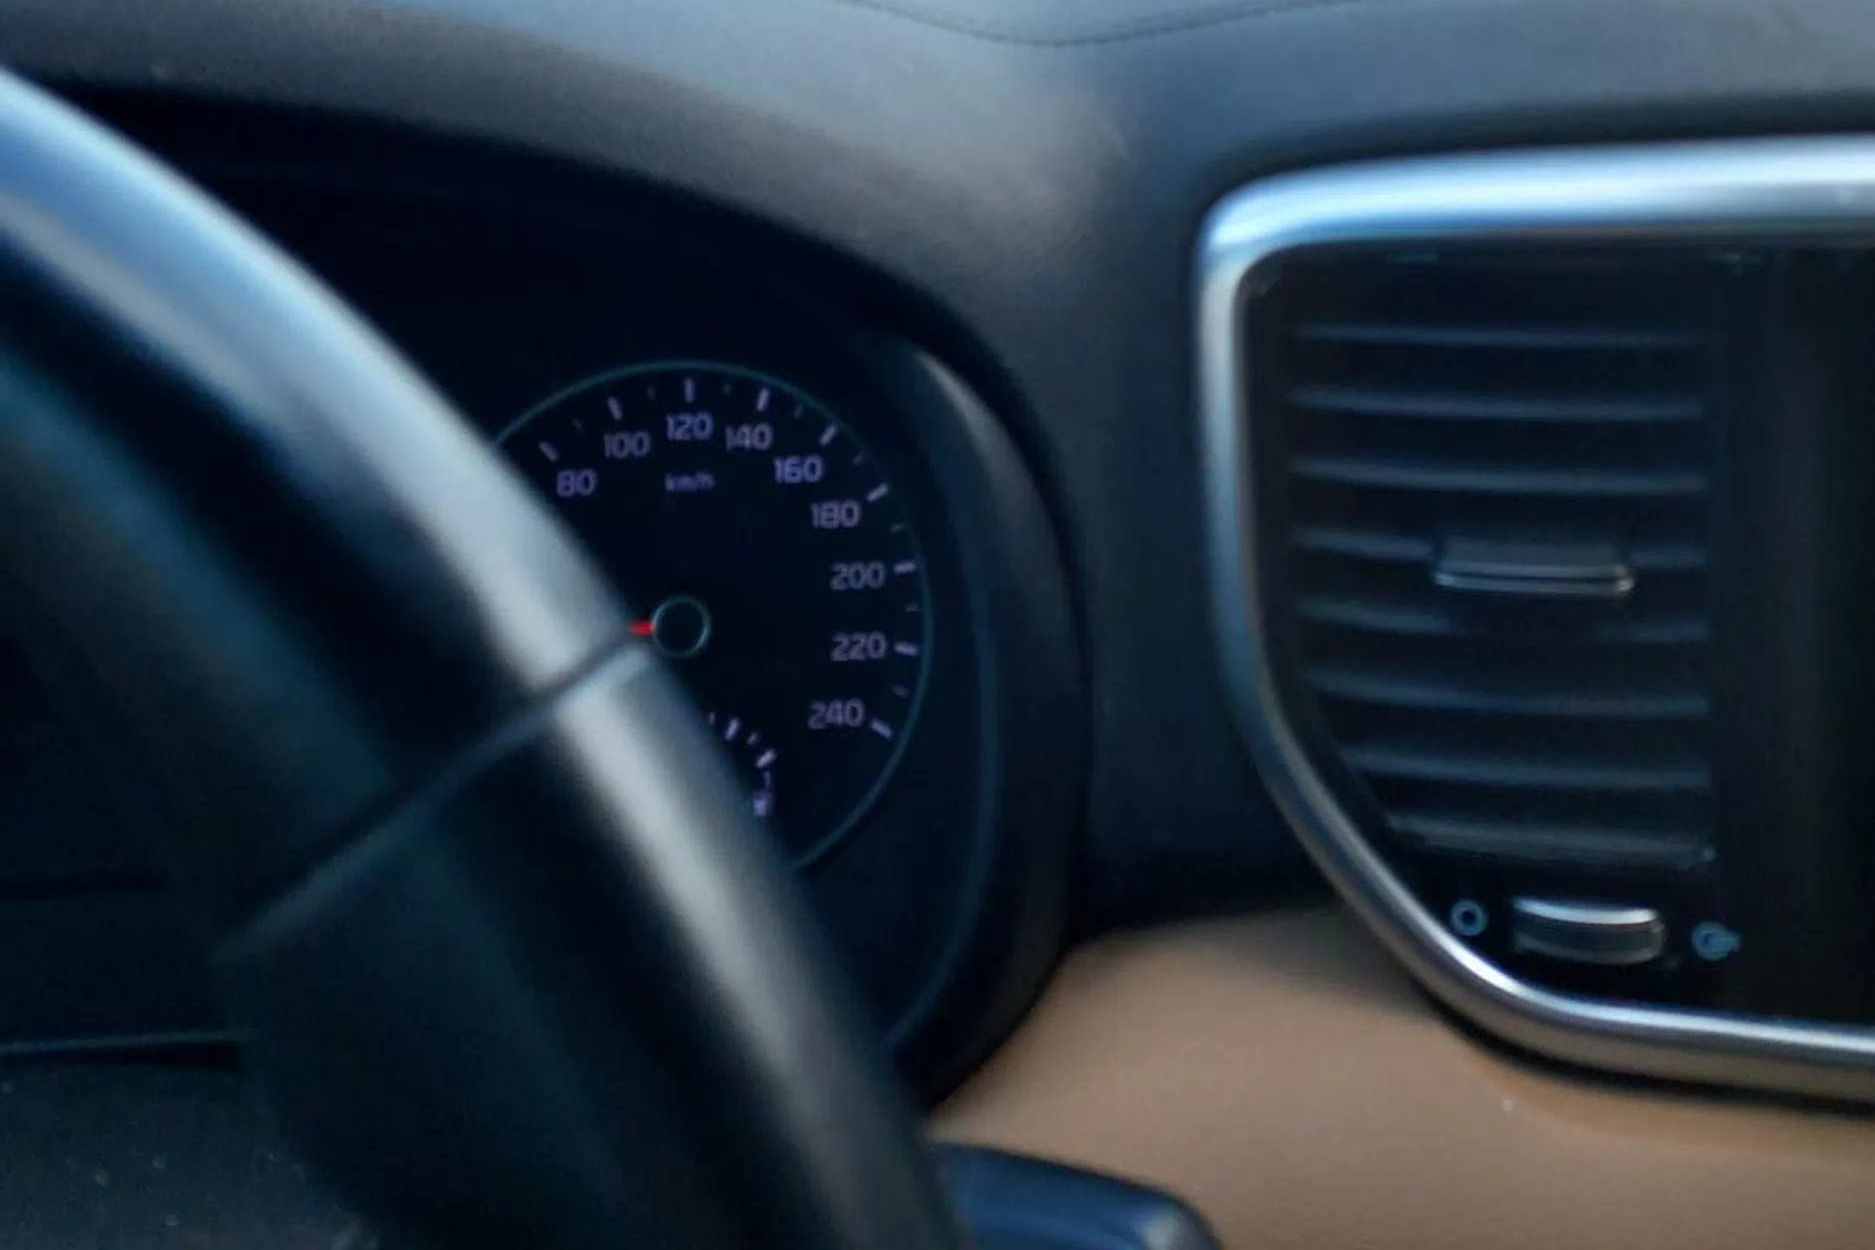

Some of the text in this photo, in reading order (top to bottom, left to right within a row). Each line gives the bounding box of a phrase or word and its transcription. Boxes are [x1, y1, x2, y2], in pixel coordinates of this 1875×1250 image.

[666, 412, 713, 441] 120
[724, 424, 773, 451] 140
[604, 431, 651, 459] 100
[556, 468, 597, 497] 80
[773, 455, 823, 484] 160
[810, 500, 861, 529] 180
[830, 561, 886, 591] 200
[831, 631, 887, 662] 220
[808, 699, 865, 730] 240
